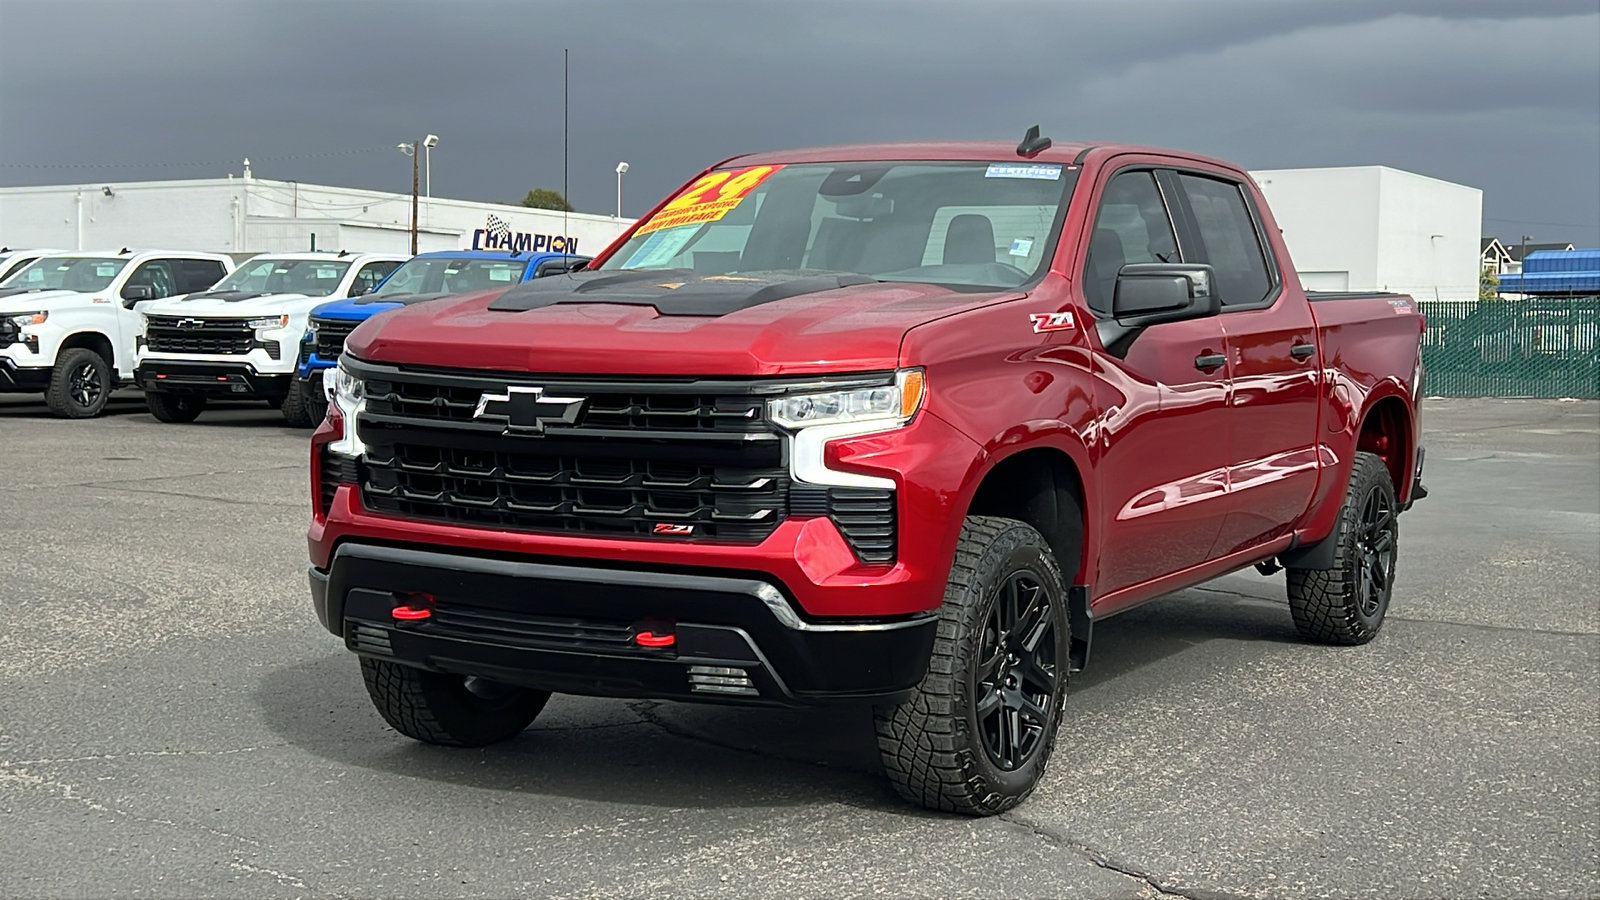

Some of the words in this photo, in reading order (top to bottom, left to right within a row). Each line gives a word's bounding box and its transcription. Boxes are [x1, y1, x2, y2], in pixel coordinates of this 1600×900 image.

[989, 166, 1058, 176] CERTIFIED
[664, 166, 773, 210] 24
[664, 210, 723, 227] MILEAGE
[472, 229, 578, 254] CHAMPION
